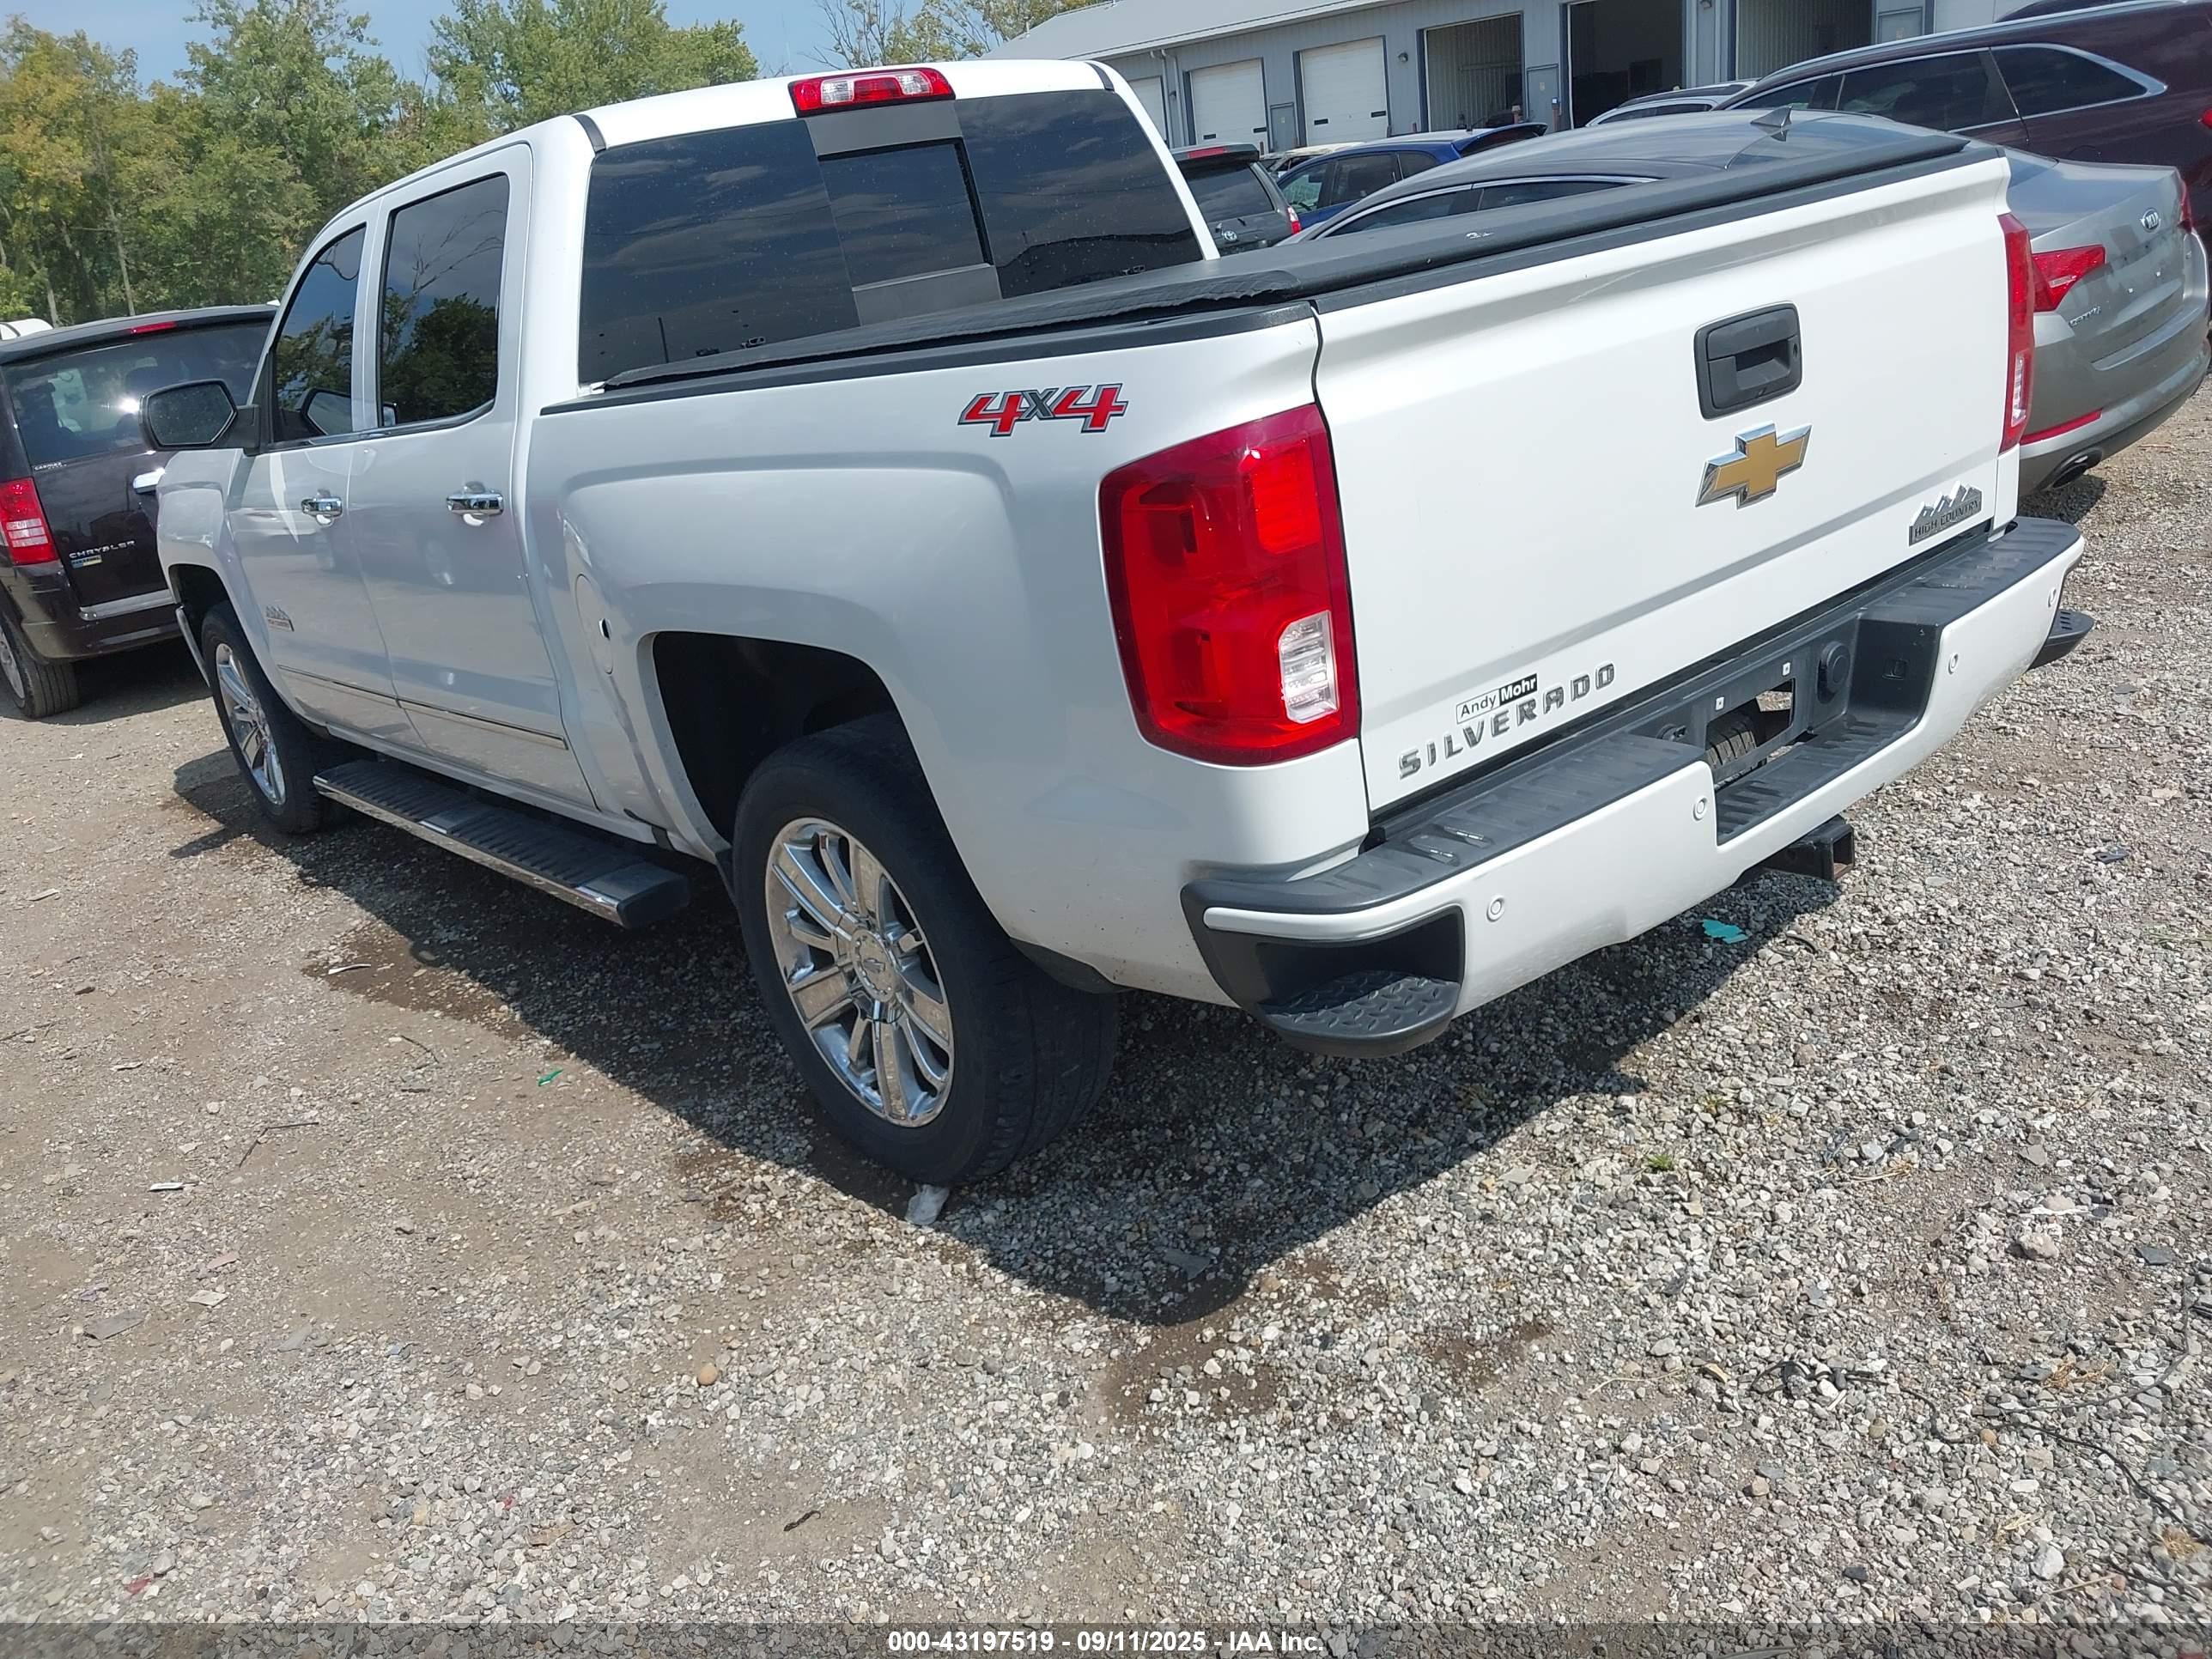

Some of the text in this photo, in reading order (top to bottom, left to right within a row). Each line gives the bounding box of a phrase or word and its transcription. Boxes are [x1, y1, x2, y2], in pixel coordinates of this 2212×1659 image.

[1914, 499, 1980, 538] HIGH COUNTRY
[1460, 676, 1537, 718] Andy Mohr
[1399, 662, 1615, 780] SILVERADO
